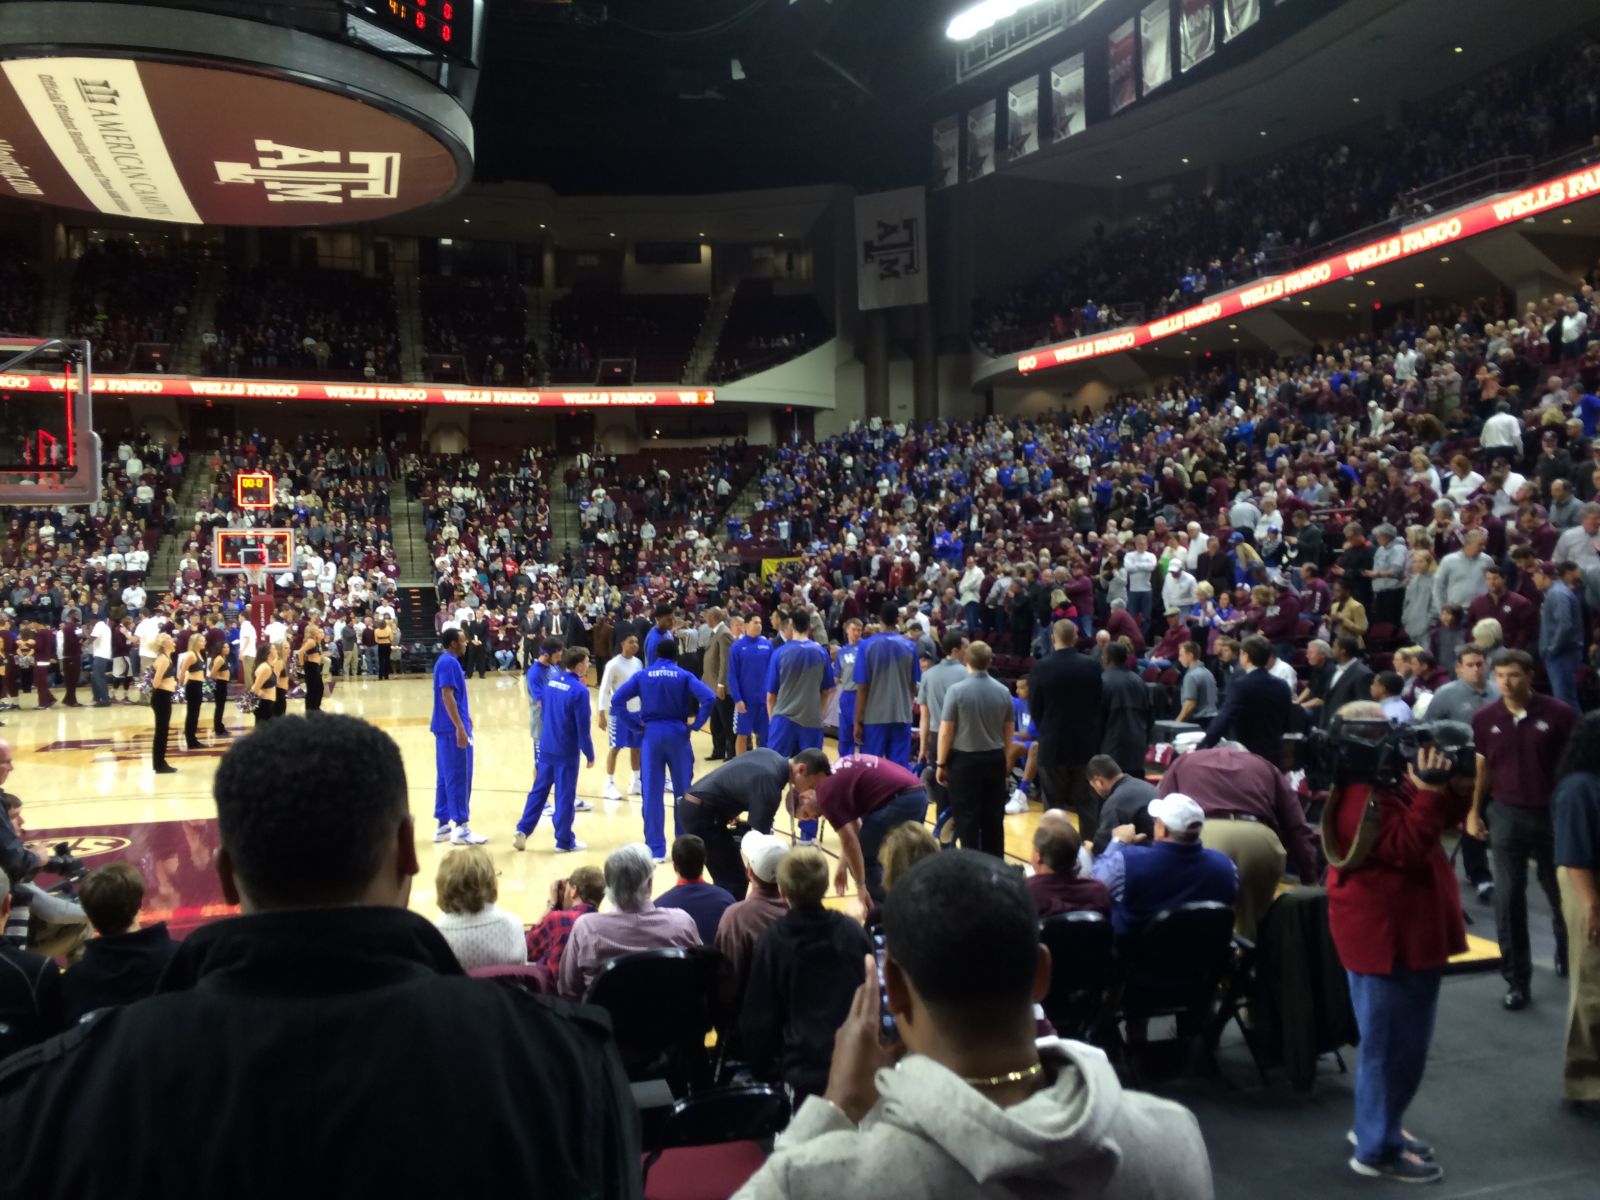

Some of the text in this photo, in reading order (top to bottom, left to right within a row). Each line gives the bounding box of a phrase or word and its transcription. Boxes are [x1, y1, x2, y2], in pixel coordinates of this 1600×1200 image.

[88, 107, 152, 179] AMERICAN
[1492, 182, 1565, 221] WELLS
[1345, 218, 1462, 270] WELLS FARGO
[1239, 263, 1331, 307] WELLS FARGO
[1149, 302, 1222, 338] WELLS FARGO
[1054, 332, 1135, 362] WELLS FARGO
[107, 379, 163, 392] FARGO
[190, 382, 299, 397] WELLS FARGO
[323, 386, 428, 400] WELLS FARGO
[442, 390, 540, 404] WELLS FARGO
[562, 392, 656, 404] WELLS FARGO
[648, 669, 678, 678] KENTUCKY
